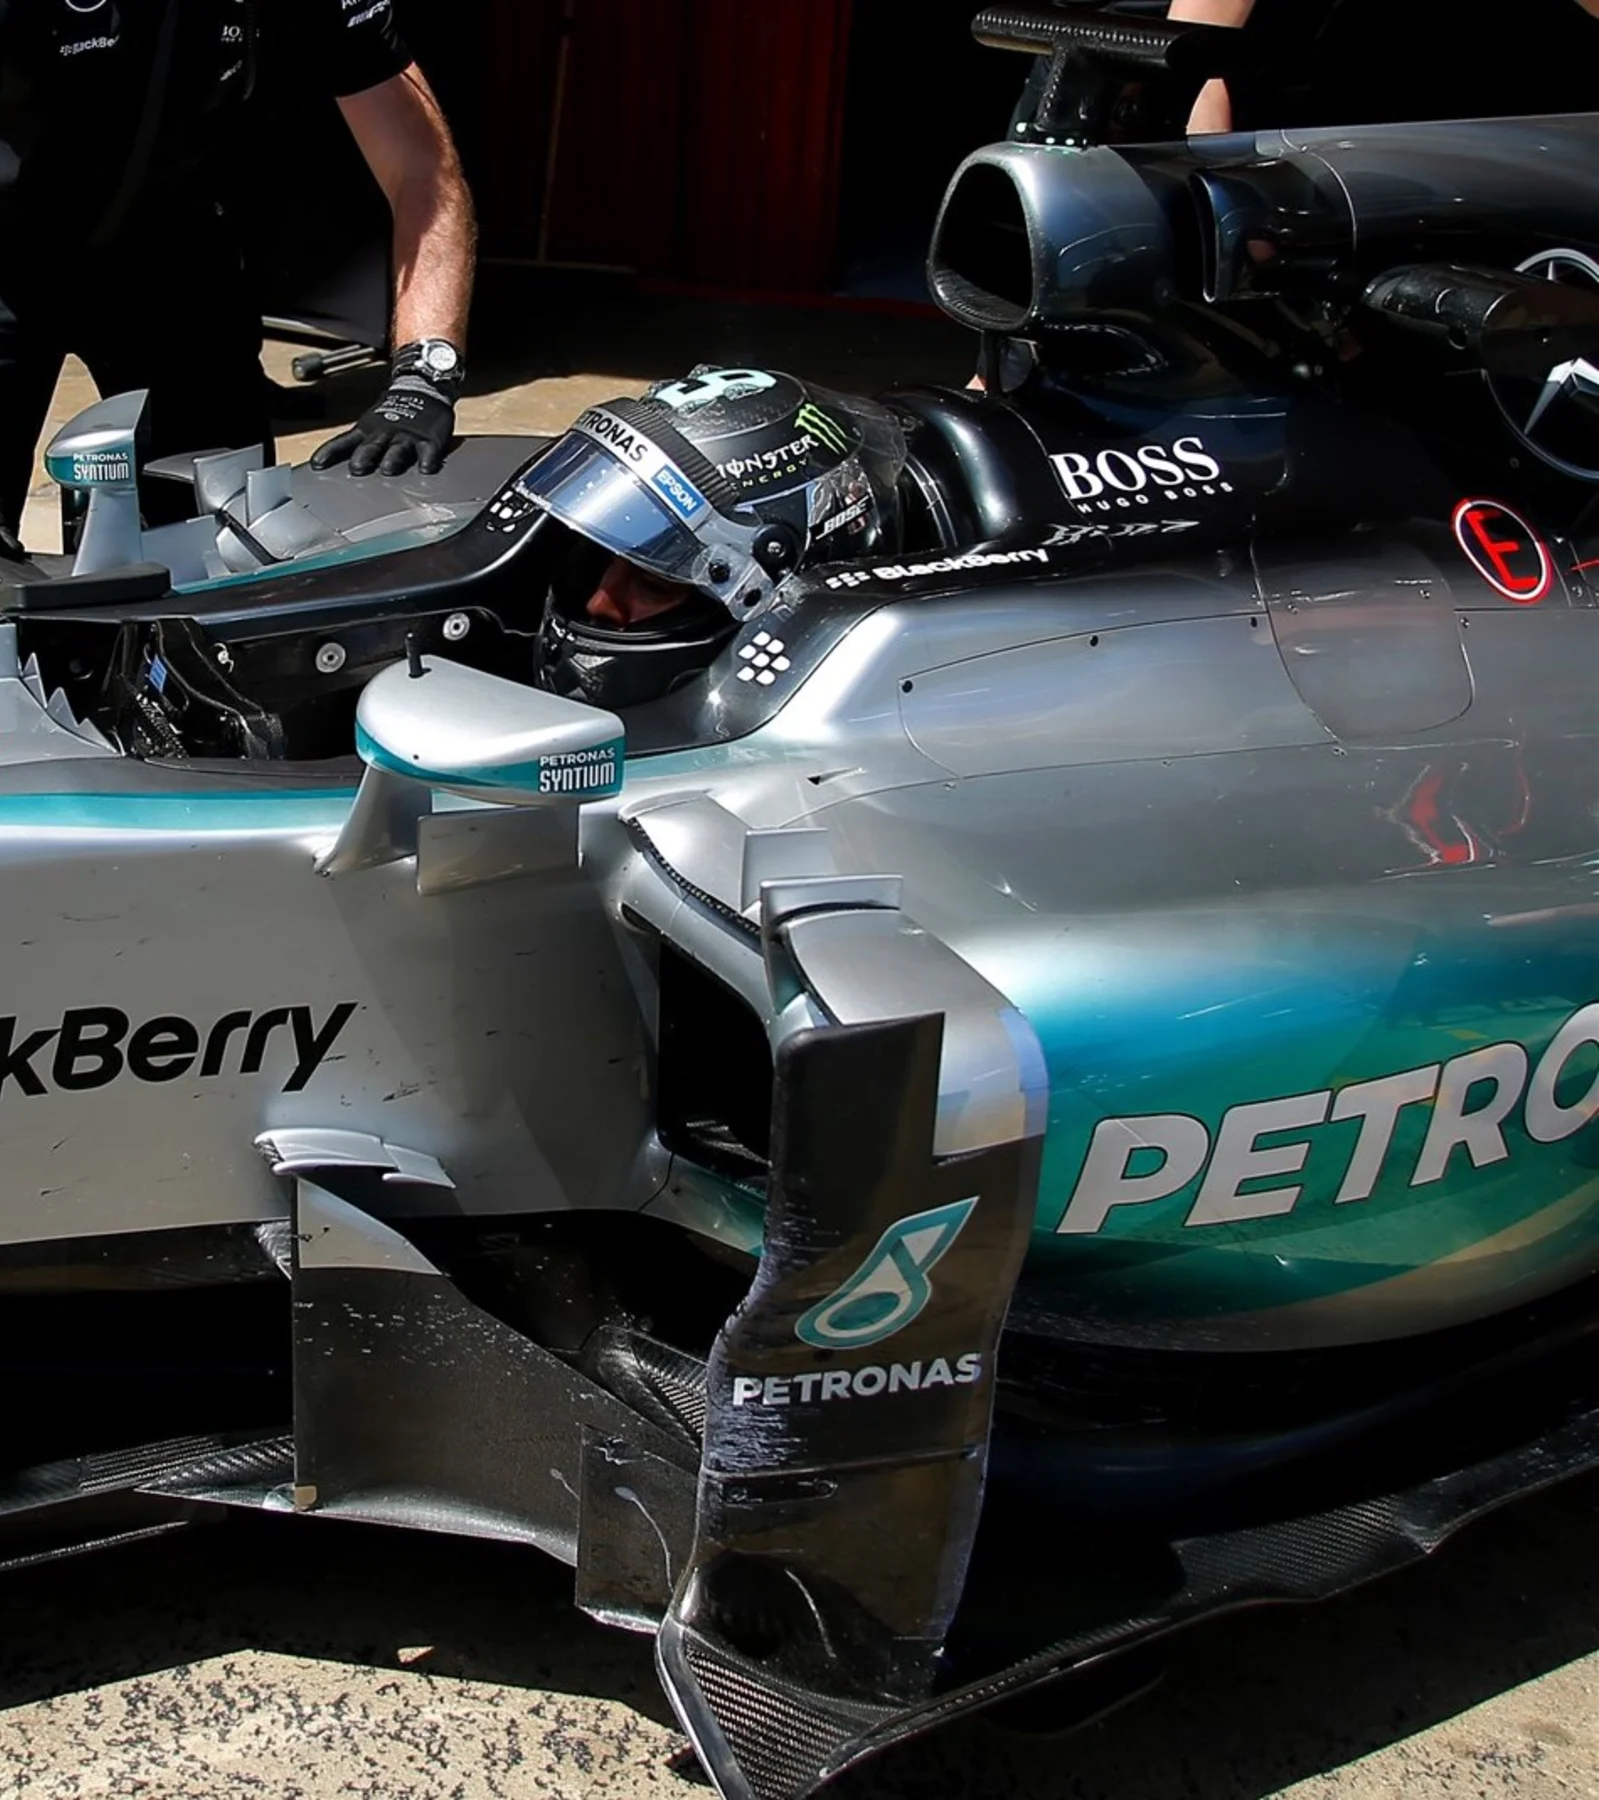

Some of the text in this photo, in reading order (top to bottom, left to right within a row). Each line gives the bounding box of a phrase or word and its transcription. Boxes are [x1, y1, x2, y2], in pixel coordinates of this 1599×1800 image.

[72, 452, 129, 462] PETRONAS
[73, 462, 129, 481] SYNTIUM
[1048, 437, 1220, 500] BOSS
[658, 471, 698, 511] EPSON
[1076, 481, 1234, 513] HUGO BOSS
[816, 496, 870, 540] BOSE
[872, 548, 1049, 580] BlackBerry
[539, 747, 615, 767] PETRONAS
[539, 762, 615, 793] SYNTIUM
[732, 1353, 982, 1406] PETRONAS
